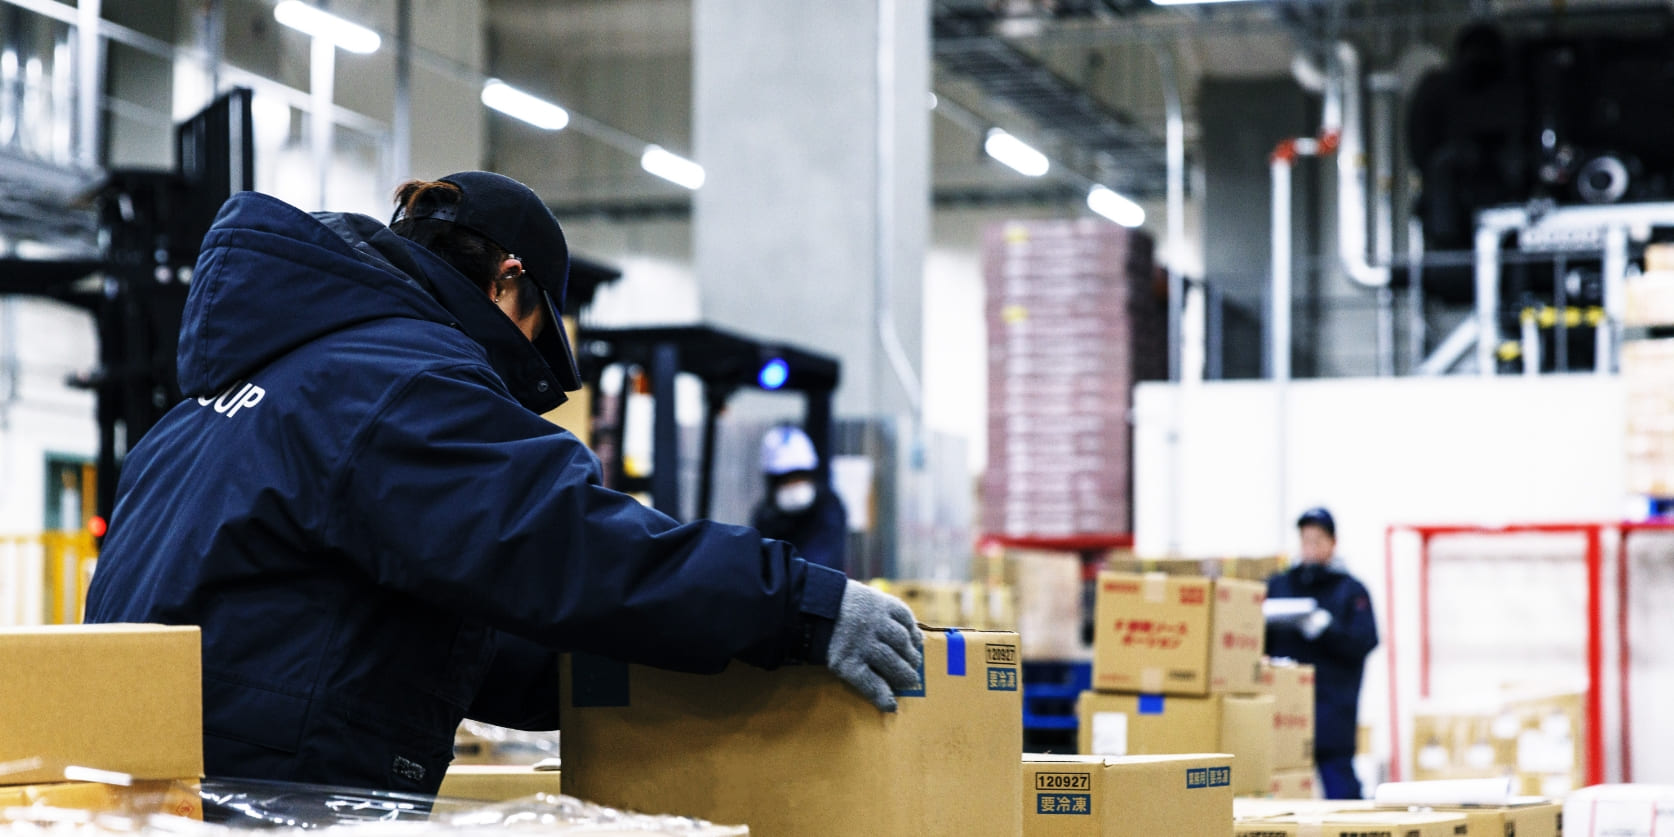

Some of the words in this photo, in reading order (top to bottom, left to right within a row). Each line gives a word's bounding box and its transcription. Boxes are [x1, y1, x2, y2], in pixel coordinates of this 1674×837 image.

[987, 647, 1015, 661] 120927
[989, 670, 1015, 688] 要冷凍
[1038, 775, 1087, 787] 120927
[1041, 796, 1087, 812] 要冷凍
